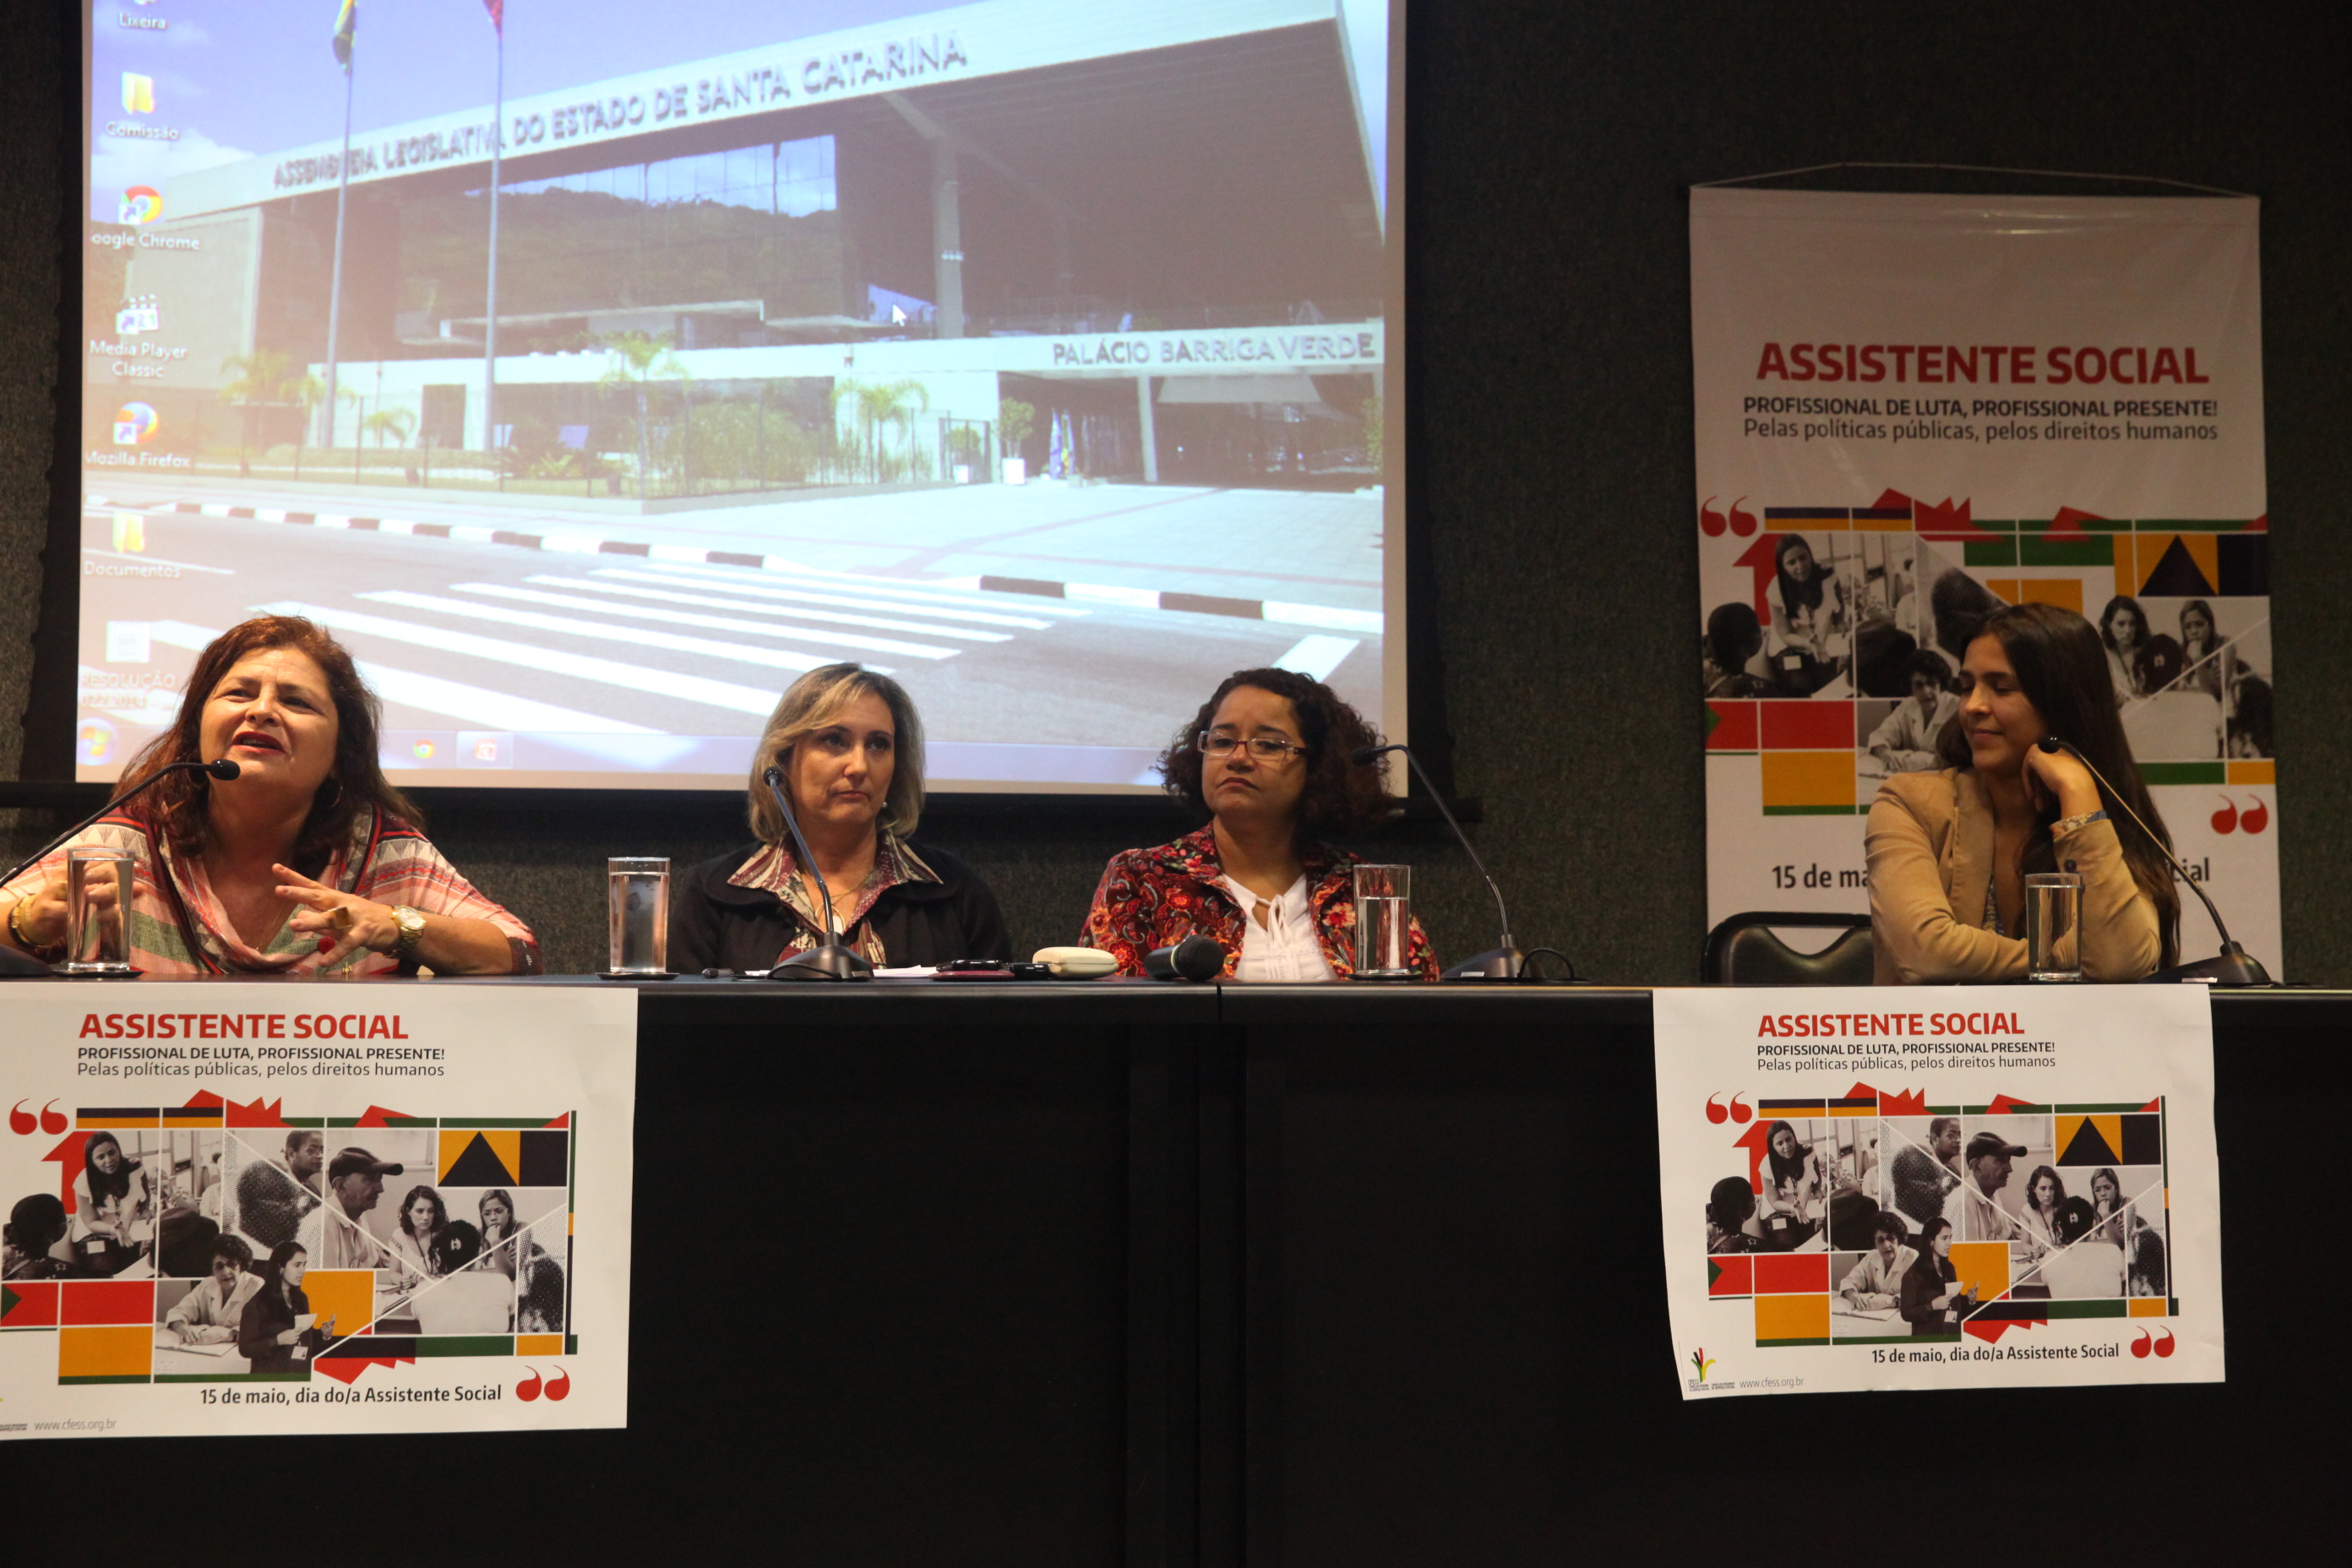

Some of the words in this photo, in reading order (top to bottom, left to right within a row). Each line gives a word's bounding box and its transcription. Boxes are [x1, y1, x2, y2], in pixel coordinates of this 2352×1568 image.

[119, 12, 167, 30] Lixeira
[514, 114, 545, 145] DO
[553, 95, 645, 139] ESTADO
[655, 83, 689, 122] DE
[697, 68, 791, 113] SANTA
[803, 29, 967, 94] CATARINA
[106, 121, 179, 140] Comissão
[139, 232, 201, 250] Chrome
[90, 340, 138, 355] Media
[141, 341, 188, 362] Player
[1053, 337, 1151, 366] PALÁCIO
[112, 361, 164, 378] Classic
[1756, 342, 2036, 384] ASSISTENTE
[2047, 346, 2209, 384] SOCIAL
[1744, 396, 1882, 415] PROFISSIONAL
[1886, 399, 1911, 416] DE
[1915, 400, 1968, 417] LUTA,
[1973, 400, 2110, 416] PROFISSIONAL
[2114, 400, 2217, 416] PRESENTE!
[1745, 419, 1799, 437] Pelas
[1805, 419, 1886, 442] políticas
[1893, 419, 1979, 444] públicas,
[1986, 420, 2038, 444] pelos
[2043, 421, 2121, 440] direitos
[2126, 422, 2218, 440] humanos
[139, 452, 190, 468] Firefox
[84, 560, 182, 579] Documentos
[1772, 865, 1796, 889] 15
[1804, 863, 1832, 888] de
[79, 1014, 286, 1038] ASSISTENTE
[294, 1015, 408, 1039] SOCIAL
[1758, 1014, 1924, 1037] ASSISTENTE
[1930, 1013, 2024, 1035] SOCIAL
[79, 1048, 187, 1059] PROFISSIONAL
[191, 1048, 210, 1059] DE
[214, 1048, 253, 1060] LUTA,
[259, 1048, 362, 1059] PROFISSIONAL
[367, 1048, 444, 1059] PRESENTE!
[1758, 1045, 1844, 1055] PROFISSIONAL
[1848, 1044, 1863, 1054] DE
[1866, 1044, 1899, 1055] LUTA,
[1903, 1043, 1989, 1054] PROFISSIONAL
[1991, 1043, 2054, 1053] PRESENTE!
[78, 1062, 118, 1075] Pelas
[124, 1062, 189, 1079] políticas
[195, 1062, 261, 1078] públicas,
[268, 1062, 307, 1078] pelos
[313, 1062, 369, 1075] direitos
[375, 1062, 444, 1075] humanos
[1758, 1059, 1791, 1070] Pelas
[1794, 1058, 1848, 1073] políticas
[1850, 1057, 1906, 1072] públicas,
[1912, 1057, 1944, 1071] pelos
[1948, 1056, 1995, 1068] direitos
[2000, 1055, 2055, 1067] humanos
[1872, 1350, 1885, 1363] 15
[1888, 1349, 1907, 1362] de
[1909, 1348, 1946, 1364] maio,
[1949, 1347, 1971, 1361] dia
[1974, 1346, 2004, 1362] do/a
[2007, 1346, 2077, 1359] Assistente
[2082, 1343, 2119, 1358] Social
[1740, 1376, 1804, 1388] www.cfess.org.br
[201, 1389, 216, 1404] 15
[222, 1388, 241, 1403] de
[246, 1388, 290, 1406] maio,
[296, 1387, 319, 1402] dia
[325, 1386, 360, 1404] do/a
[365, 1387, 449, 1402] Assistente
[455, 1385, 501, 1401] Social
[34, 1418, 117, 1431] www.cfess.org.br
